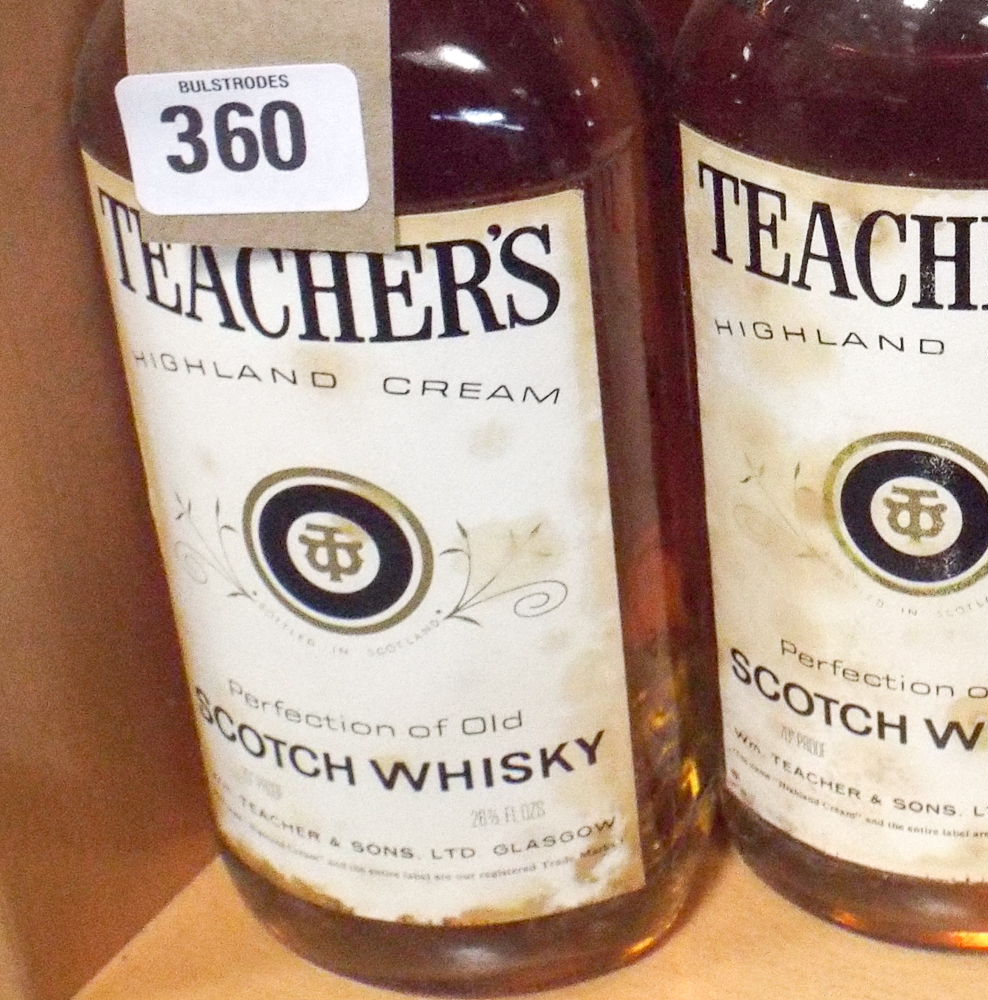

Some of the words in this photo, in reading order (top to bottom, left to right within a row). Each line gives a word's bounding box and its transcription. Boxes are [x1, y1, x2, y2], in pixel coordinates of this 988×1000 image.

[178, 74, 290, 94] BULSTRODES
[160, 100, 307, 174] 360
[98, 187, 561, 343] TEACHER'S
[714, 318, 945, 356] HIGHLAND
[131, 349, 338, 390] HIGHLAND
[382, 376, 561, 405] CREAM
[730, 647, 908, 745] SCOTCH
[780, 638, 955, 699] Perfection
[196, 686, 356, 786] SCOTCH
[370, 730, 606, 793] WHISKY
[228, 678, 397, 738] Perfection
[407, 718, 450, 740] of
[460, 709, 524, 737] Old
[771, 752, 862, 800] TEACHER
[870, 794, 883, 806] &
[430, 847, 477, 861] LTD
[492, 815, 617, 857] GLASGOW
